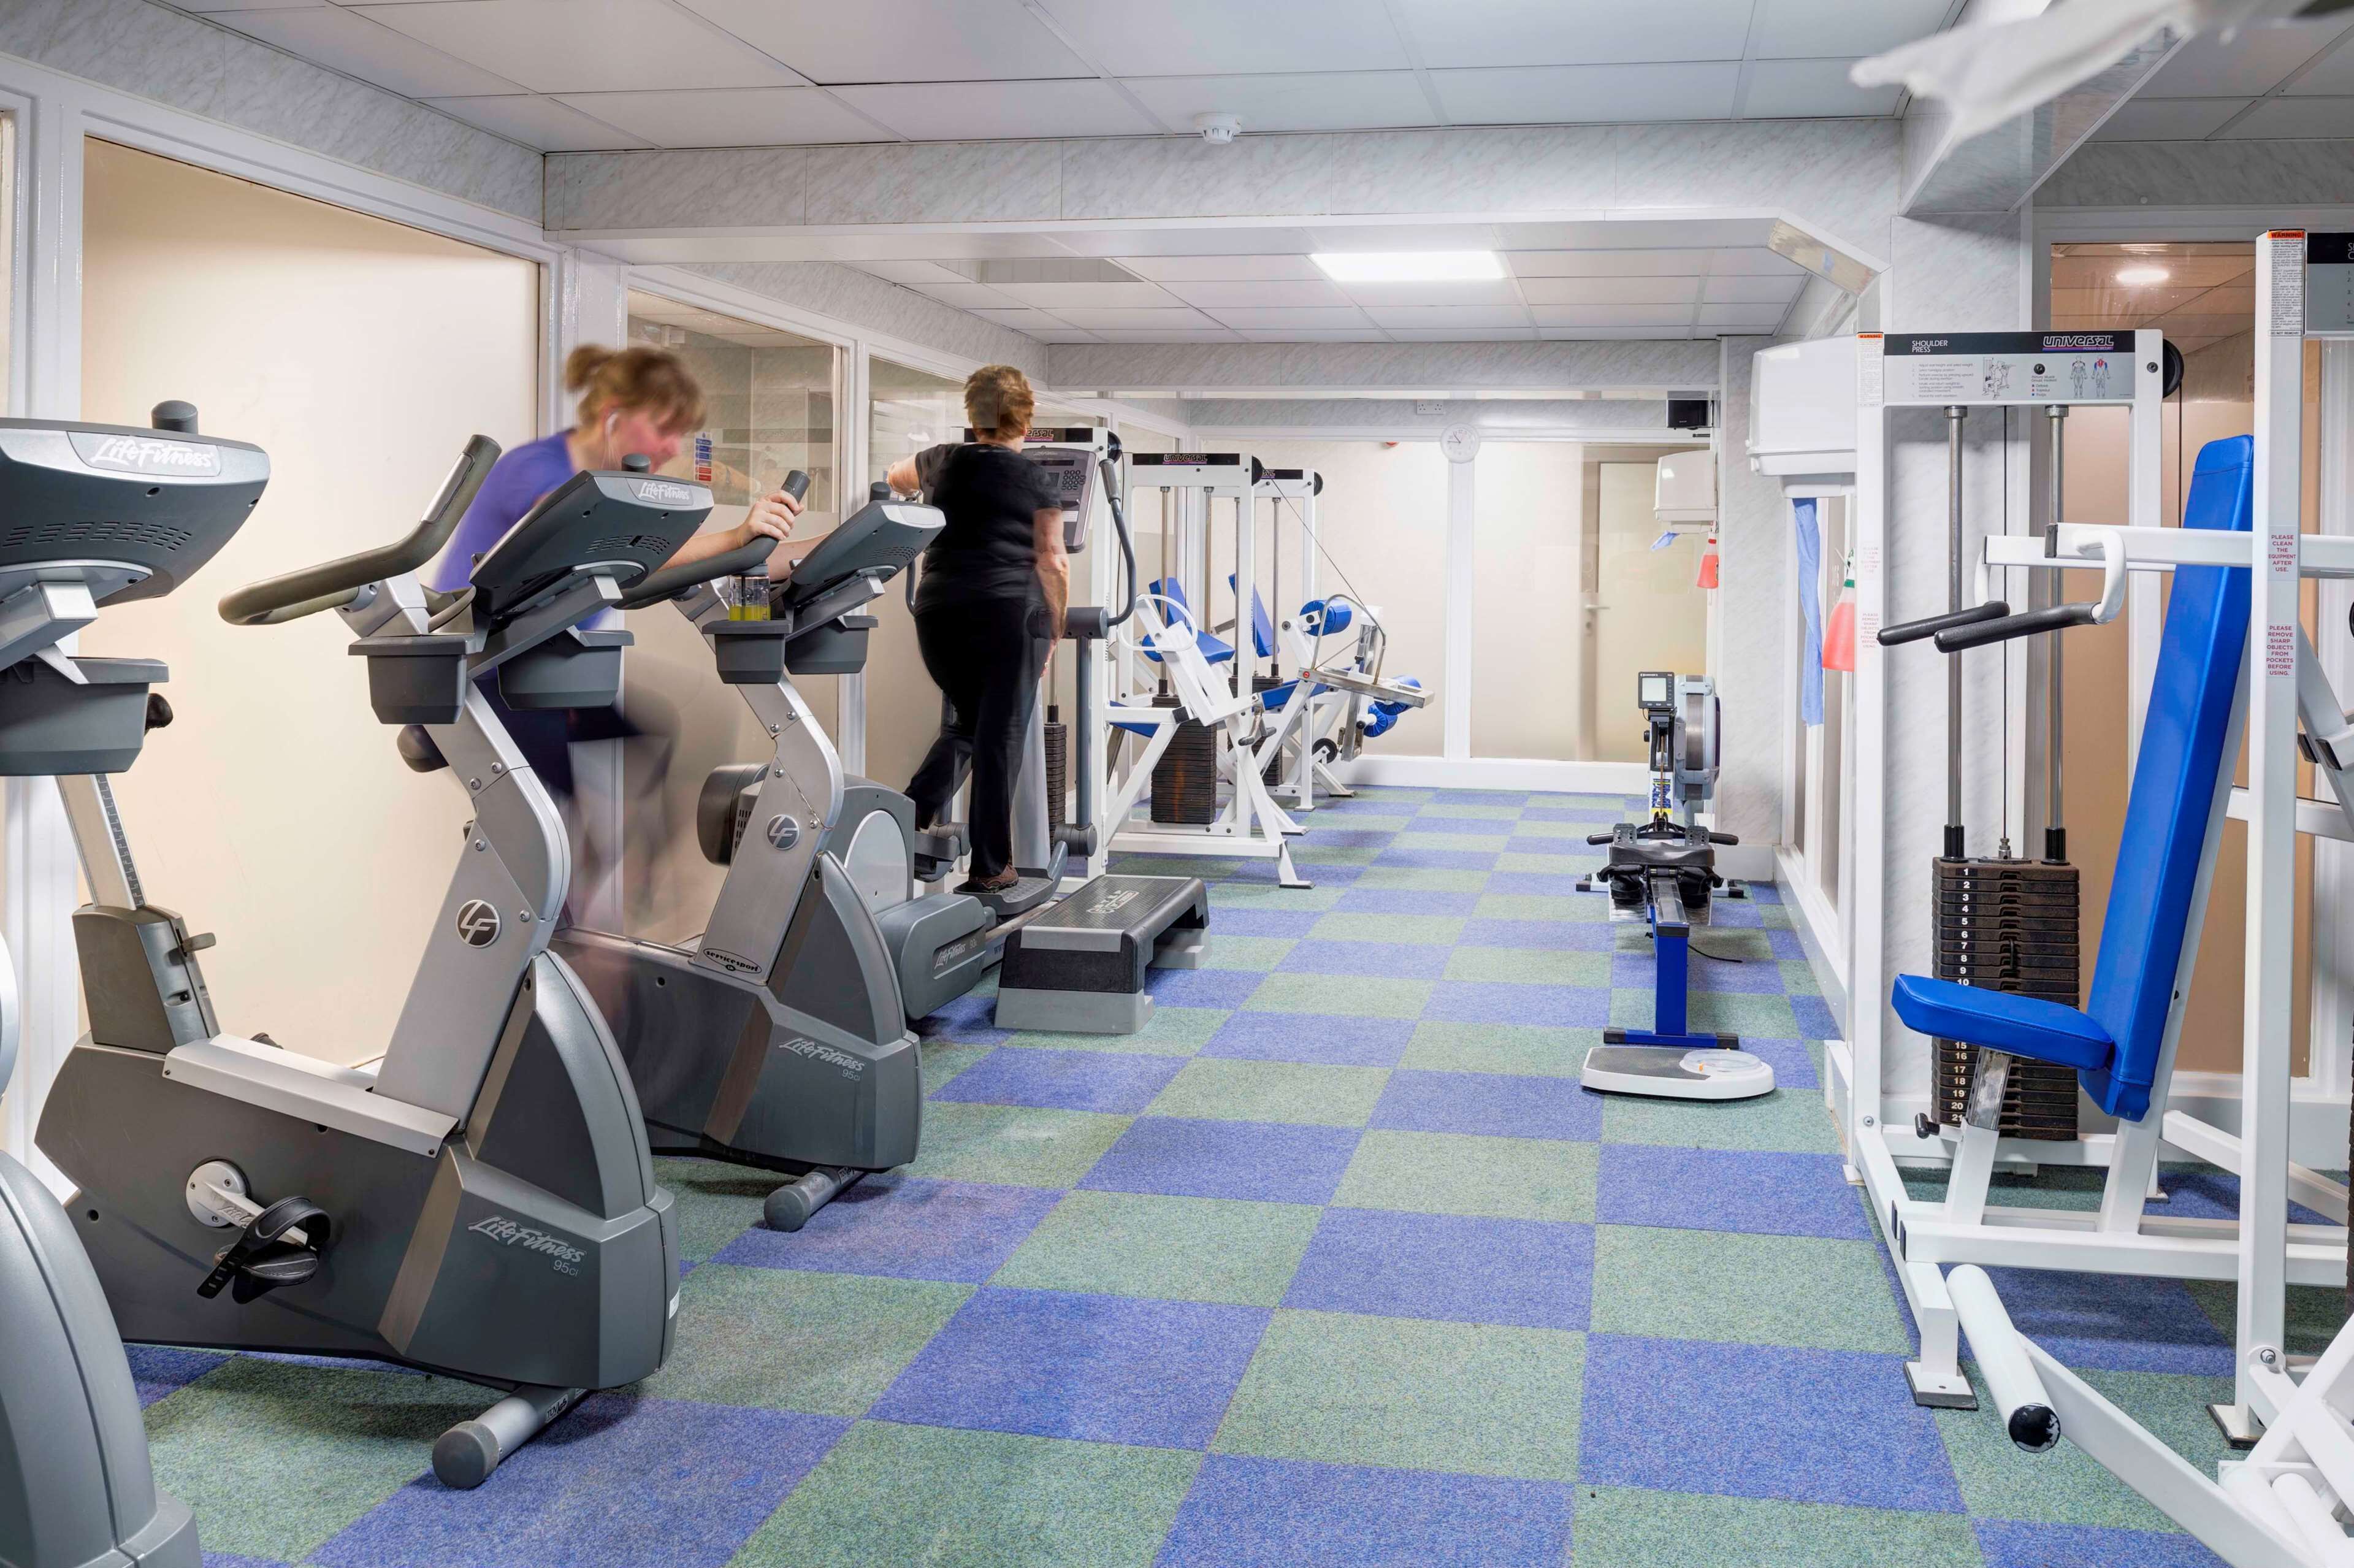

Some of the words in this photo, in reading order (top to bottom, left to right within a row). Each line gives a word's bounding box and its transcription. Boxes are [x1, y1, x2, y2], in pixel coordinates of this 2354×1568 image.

[1963, 881, 1970, 889] 2
[1962, 904, 1969, 913] 4
[1960, 954, 1968, 963] 8
[1953, 1089, 1965, 1098] 19
[1951, 1101, 1963, 1110] 20
